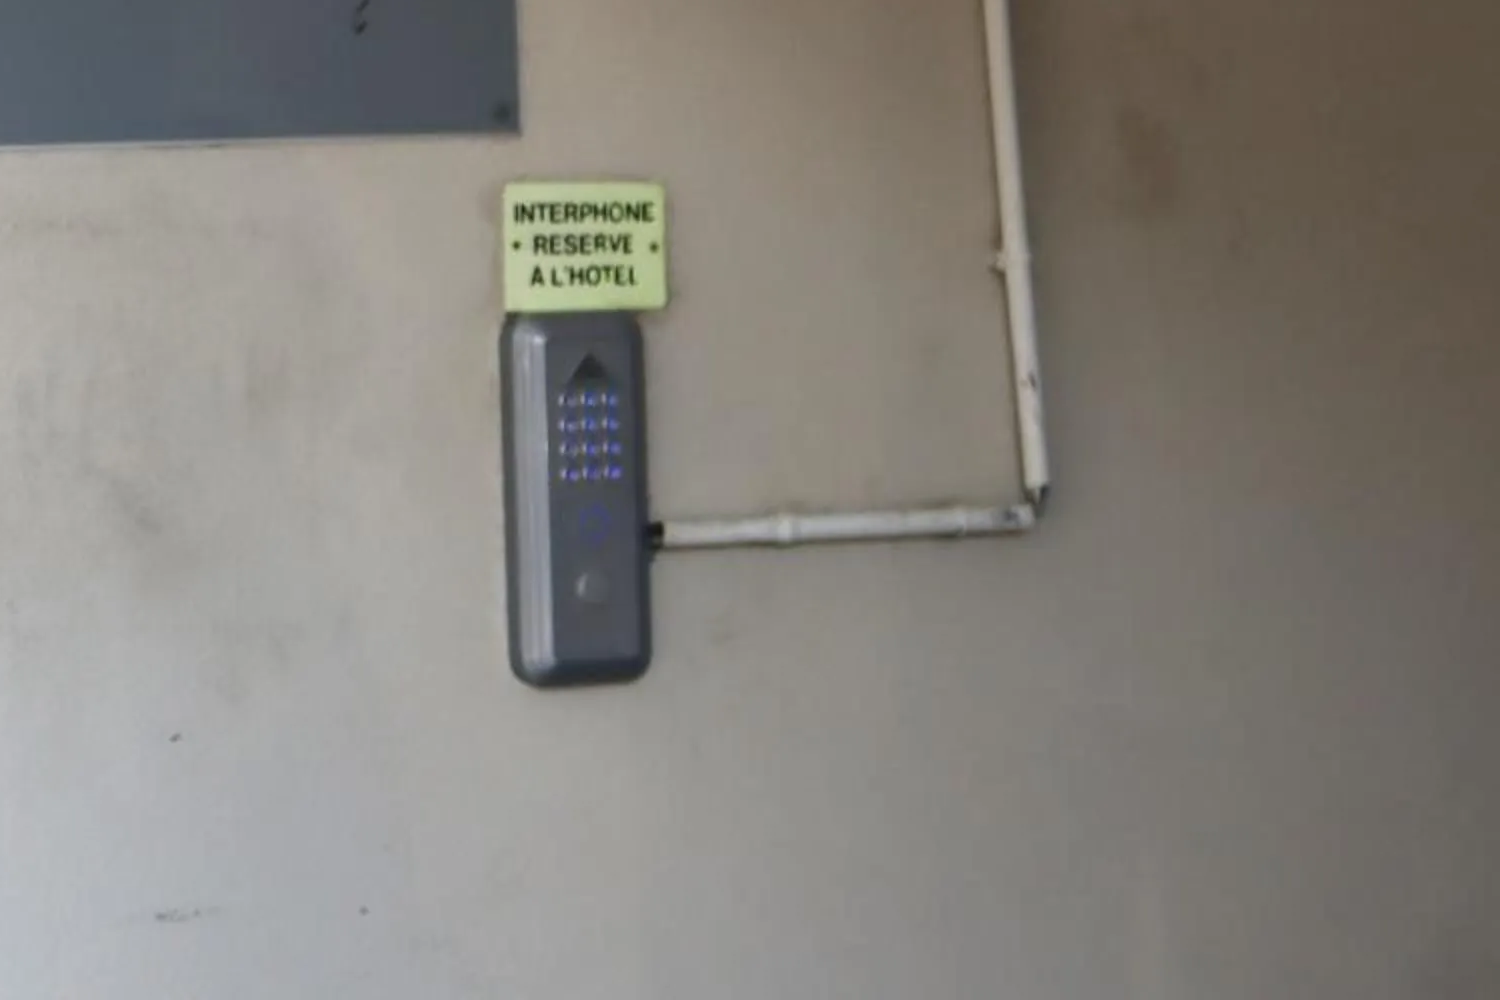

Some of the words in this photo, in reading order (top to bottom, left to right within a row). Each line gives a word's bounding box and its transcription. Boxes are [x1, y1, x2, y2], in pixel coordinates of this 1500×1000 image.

[513, 202, 655, 224] INTERPHONE
[533, 234, 633, 255] RESERVE
[531, 264, 545, 286] A
